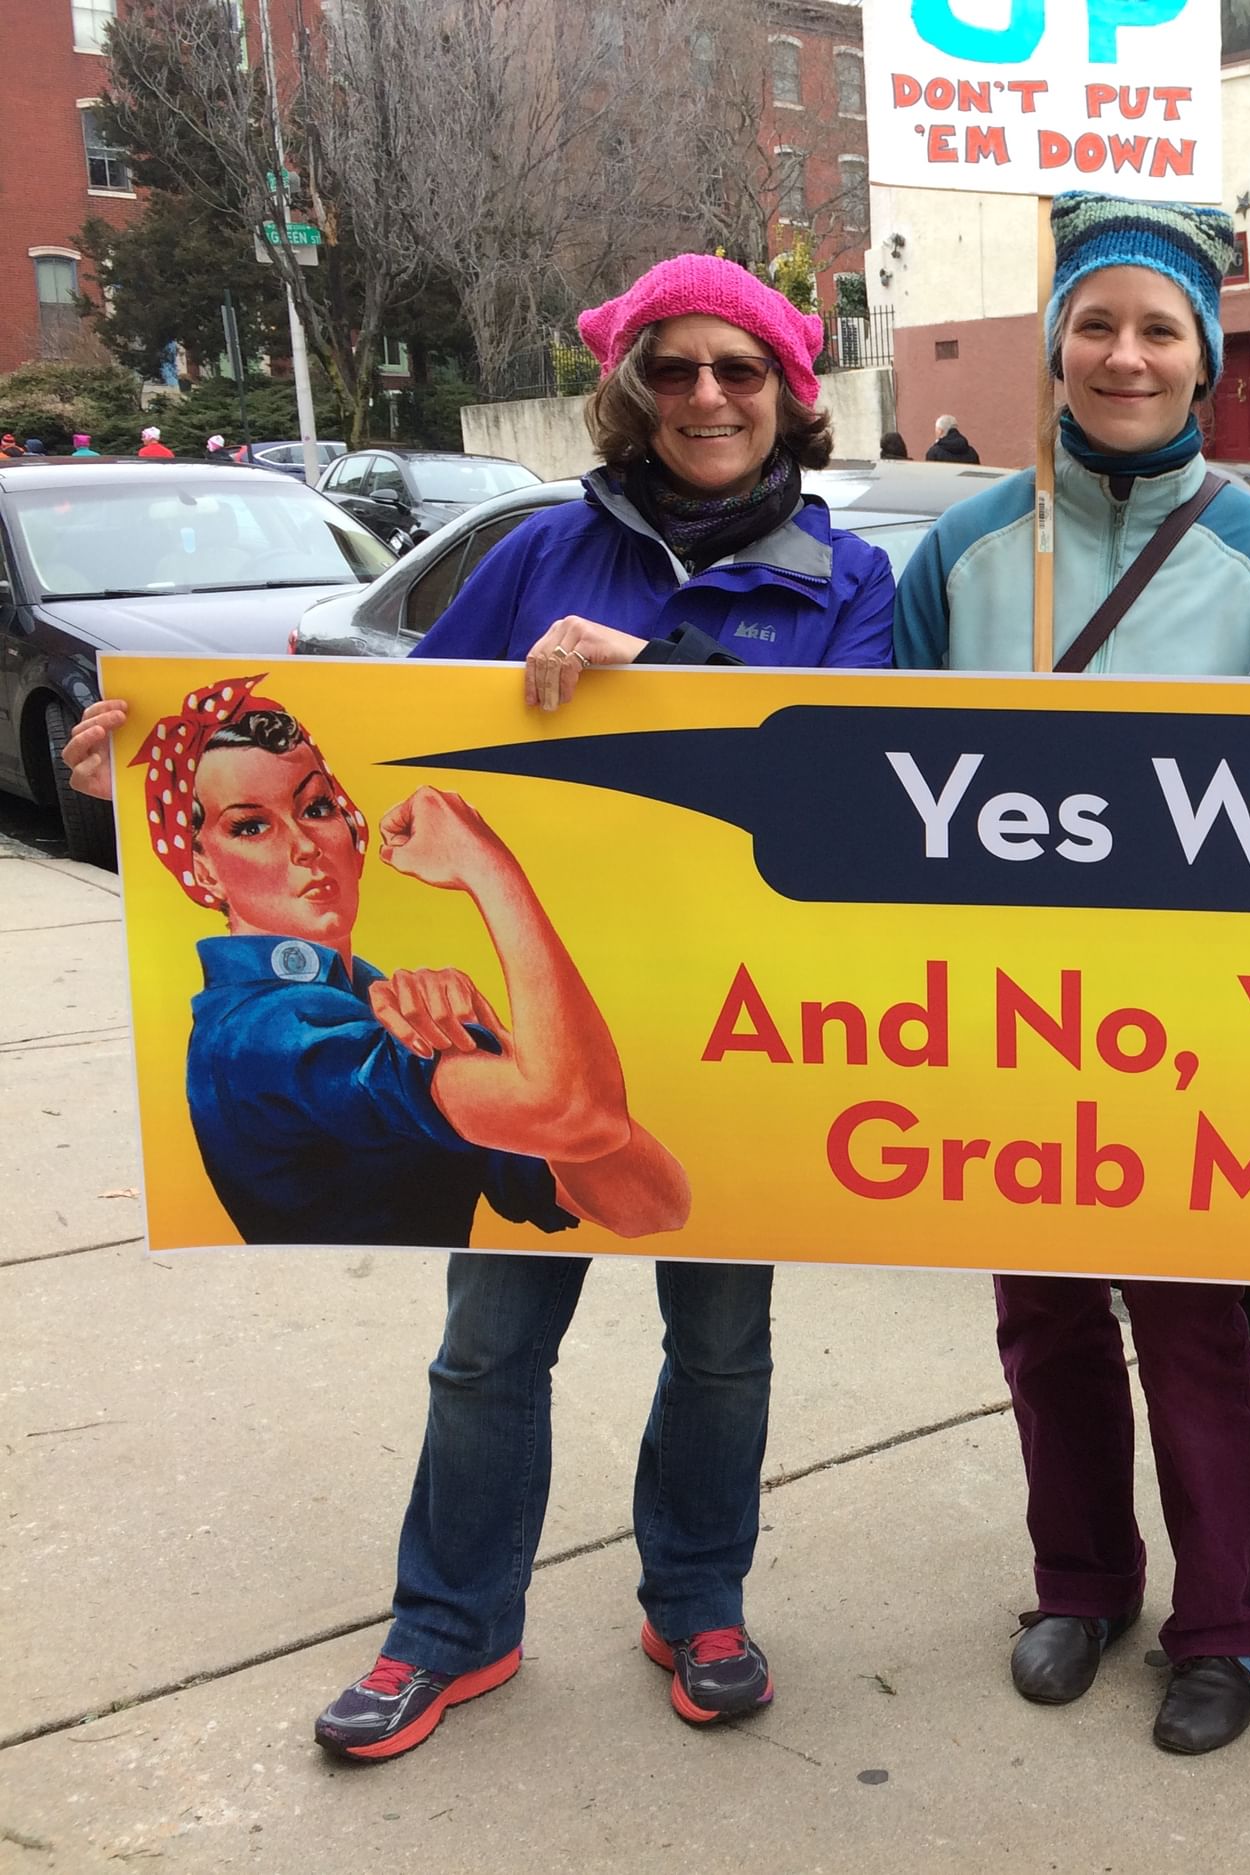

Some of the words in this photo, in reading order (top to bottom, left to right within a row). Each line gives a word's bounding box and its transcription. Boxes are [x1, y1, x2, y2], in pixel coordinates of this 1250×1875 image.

[891, 73, 1049, 114] DON'T
[1084, 82, 1193, 121] PUT
[914, 124, 1012, 166] 'EM
[1037, 129, 1197, 178] DOWN
[270, 231, 308, 244] GEEN
[884, 751, 1113, 863] Yes
[700, 960, 949, 1068] And
[996, 967, 1199, 1091] No,
[826, 1100, 1145, 1209] Grab
